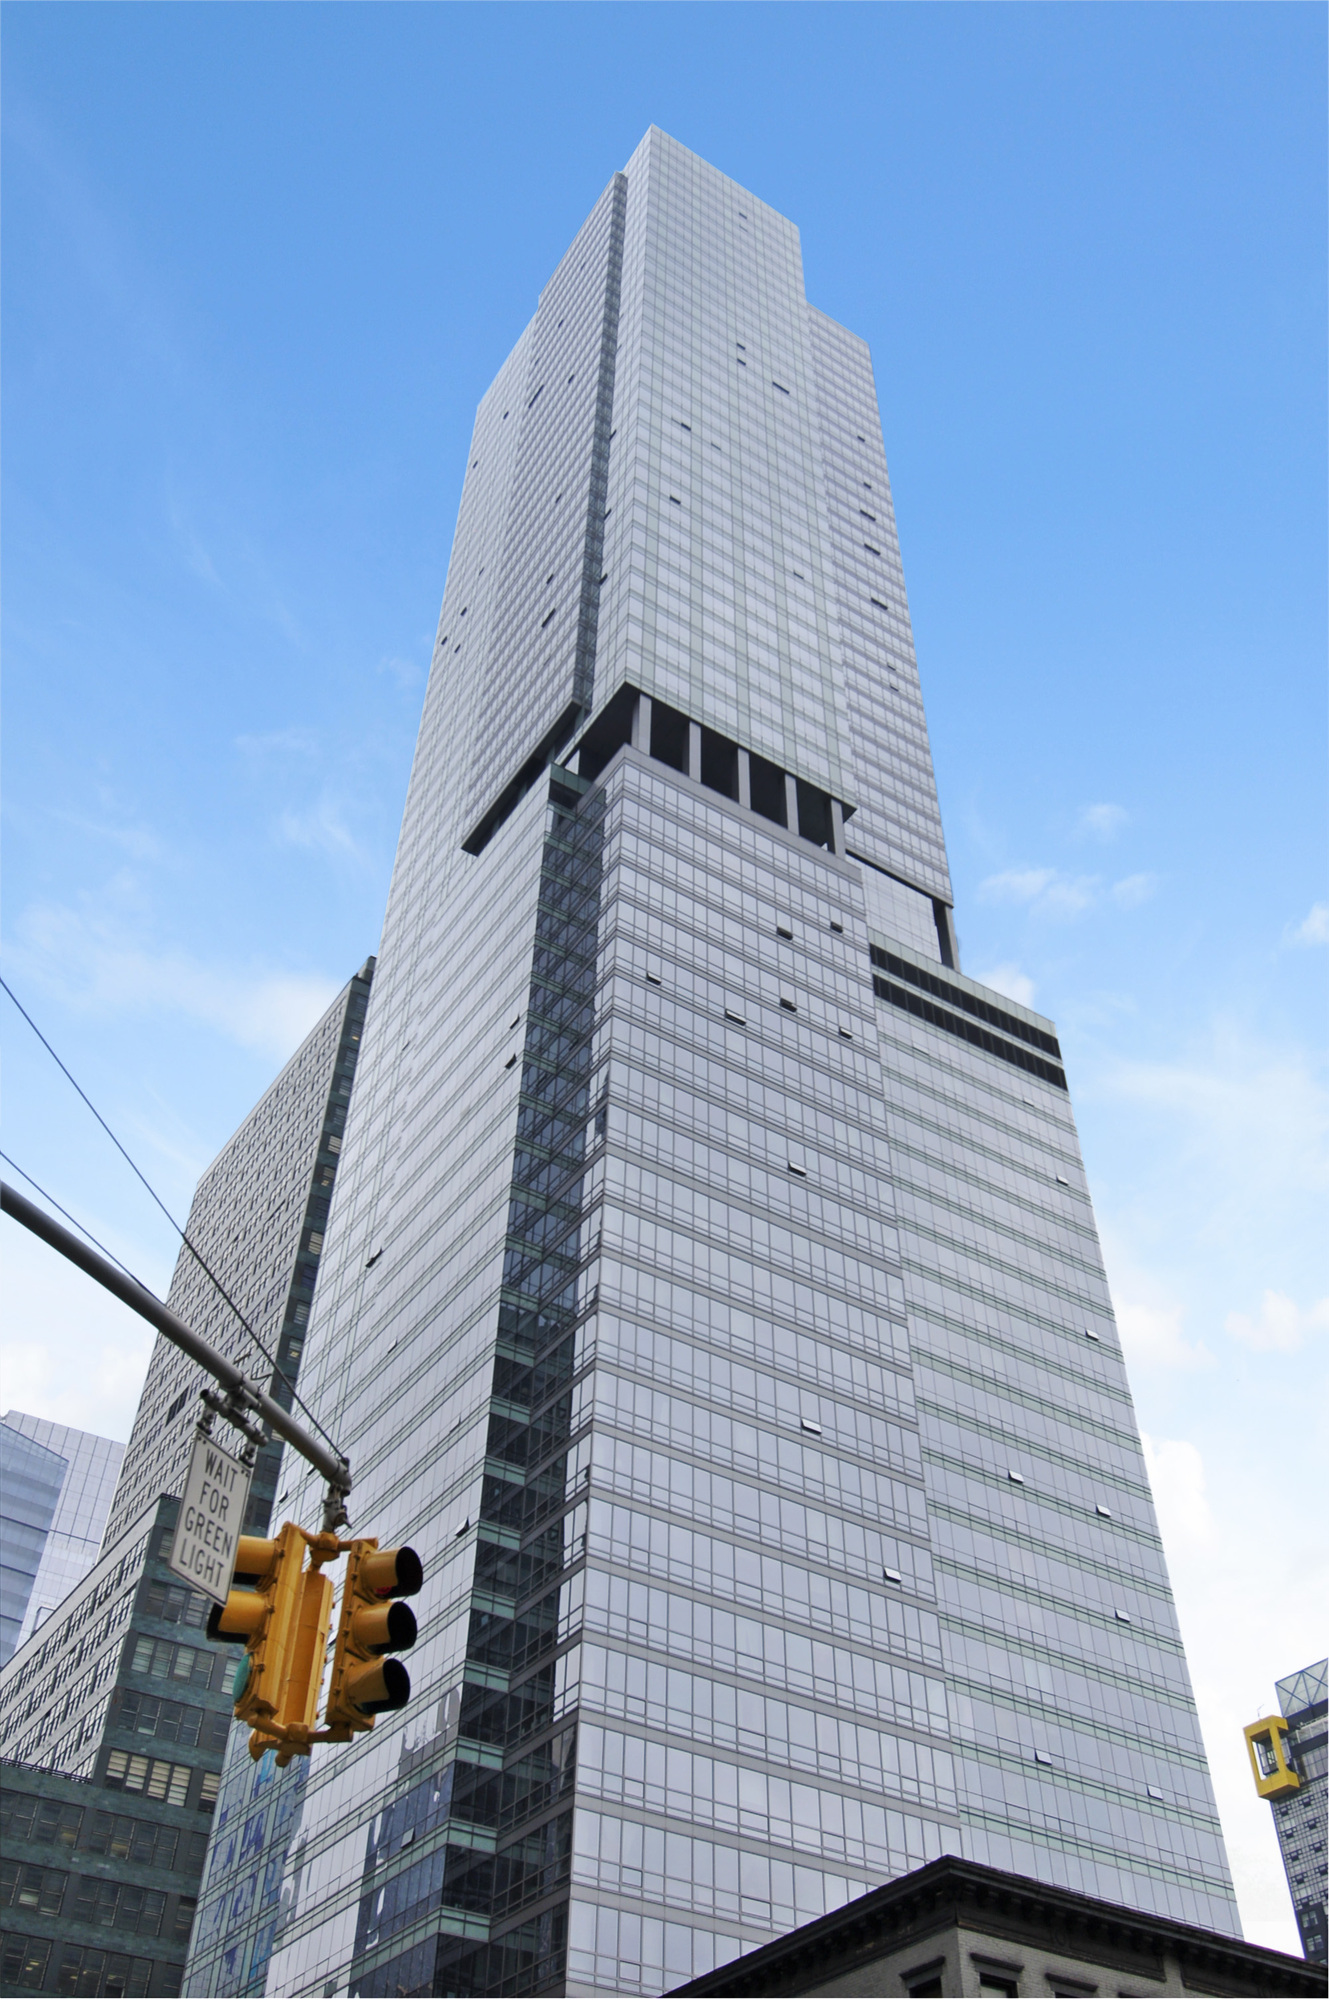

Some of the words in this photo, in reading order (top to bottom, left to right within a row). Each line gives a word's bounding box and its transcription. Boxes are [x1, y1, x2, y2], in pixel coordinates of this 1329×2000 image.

[204, 1449, 238, 1492] WAIT
[199, 1480, 230, 1522] FOR
[184, 1506, 233, 1559] GREEN
[179, 1538, 224, 1587] LIGHT
